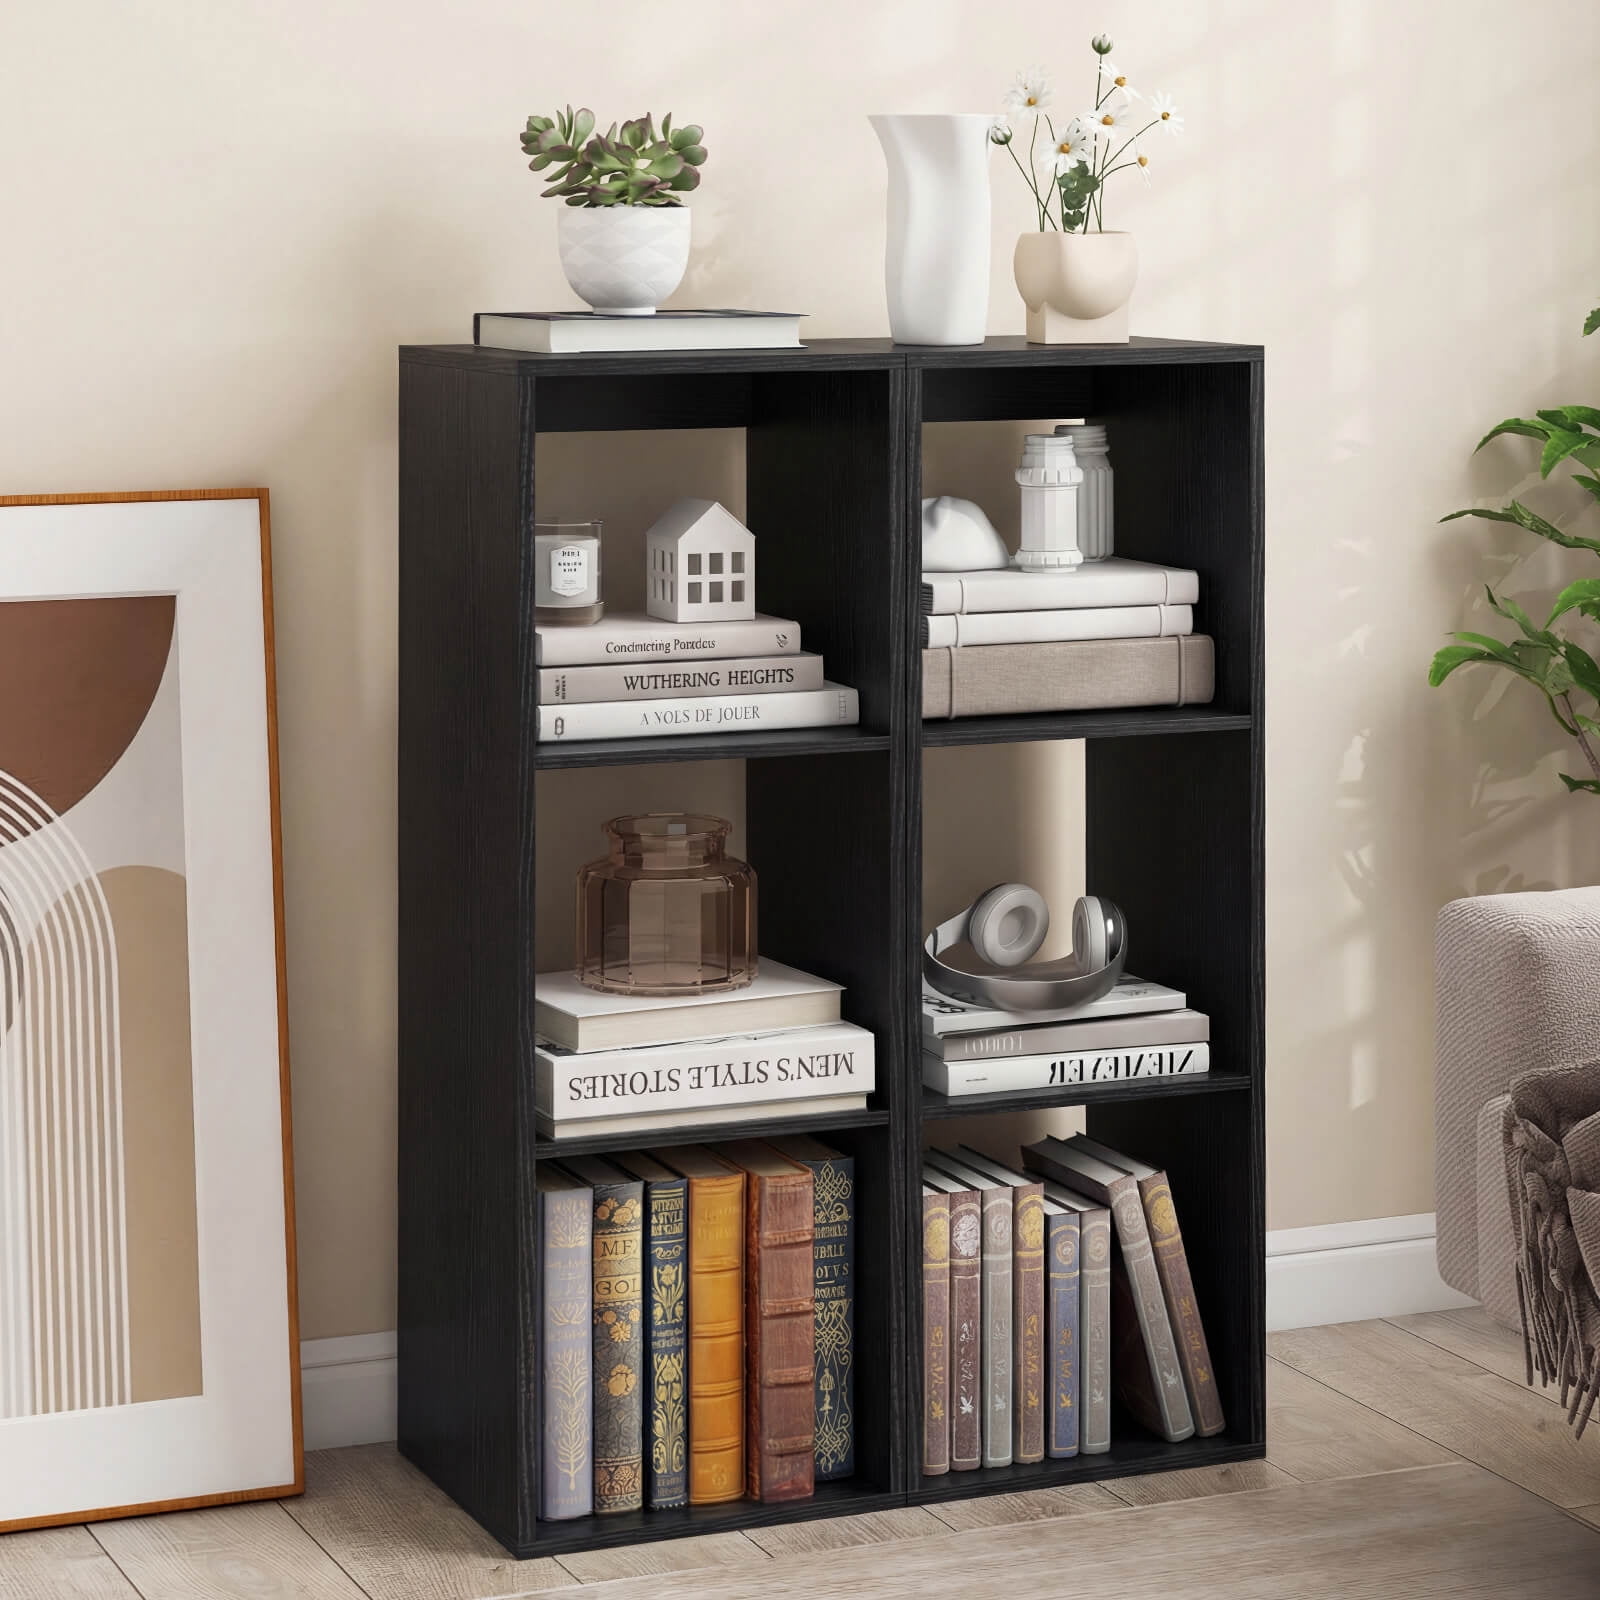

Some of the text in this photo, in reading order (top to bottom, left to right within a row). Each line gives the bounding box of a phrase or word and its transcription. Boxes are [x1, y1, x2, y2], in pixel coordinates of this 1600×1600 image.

[623, 668, 794, 691] WUTHERING HEIGHTS
[717, 705, 761, 722] JOUER
[568, 1051, 855, 1101] MEN'S STYLE STORIES
